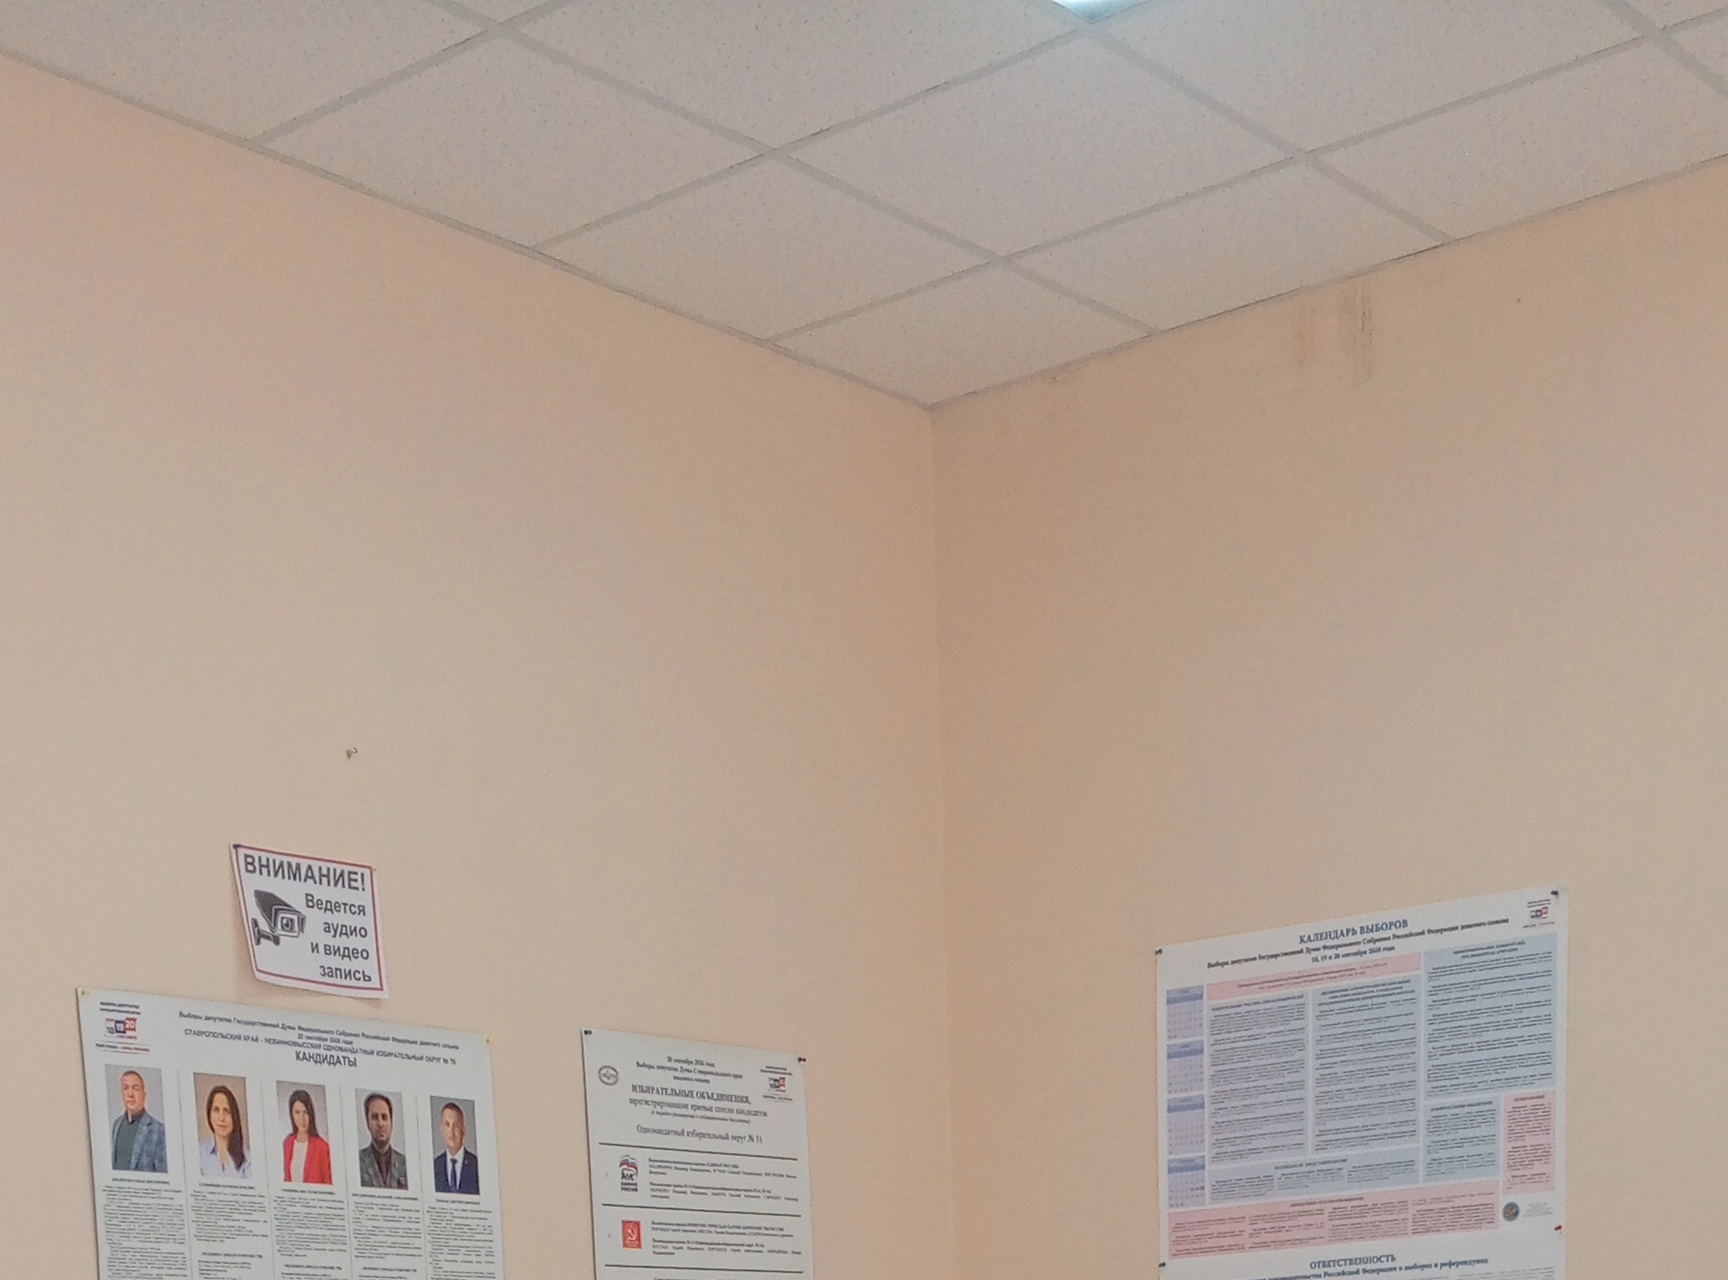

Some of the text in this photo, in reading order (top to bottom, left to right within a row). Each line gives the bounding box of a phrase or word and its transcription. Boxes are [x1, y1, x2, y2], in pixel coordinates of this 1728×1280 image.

[244, 853, 366, 892] ВНИМАНИЕ!
[305, 893, 366, 917] Ведется
[323, 921, 368, 939] аудио
[1299, 919, 1408, 944] КАЛЕНДАРЬ ВЫБОРОВ
[310, 941, 370, 961] и видео
[319, 965, 372, 982] запись
[295, 1051, 357, 1067] КАНДИДАТЫ
[1309, 1254, 1396, 1270] ОТВЕТСТВЕННОСТЬ
